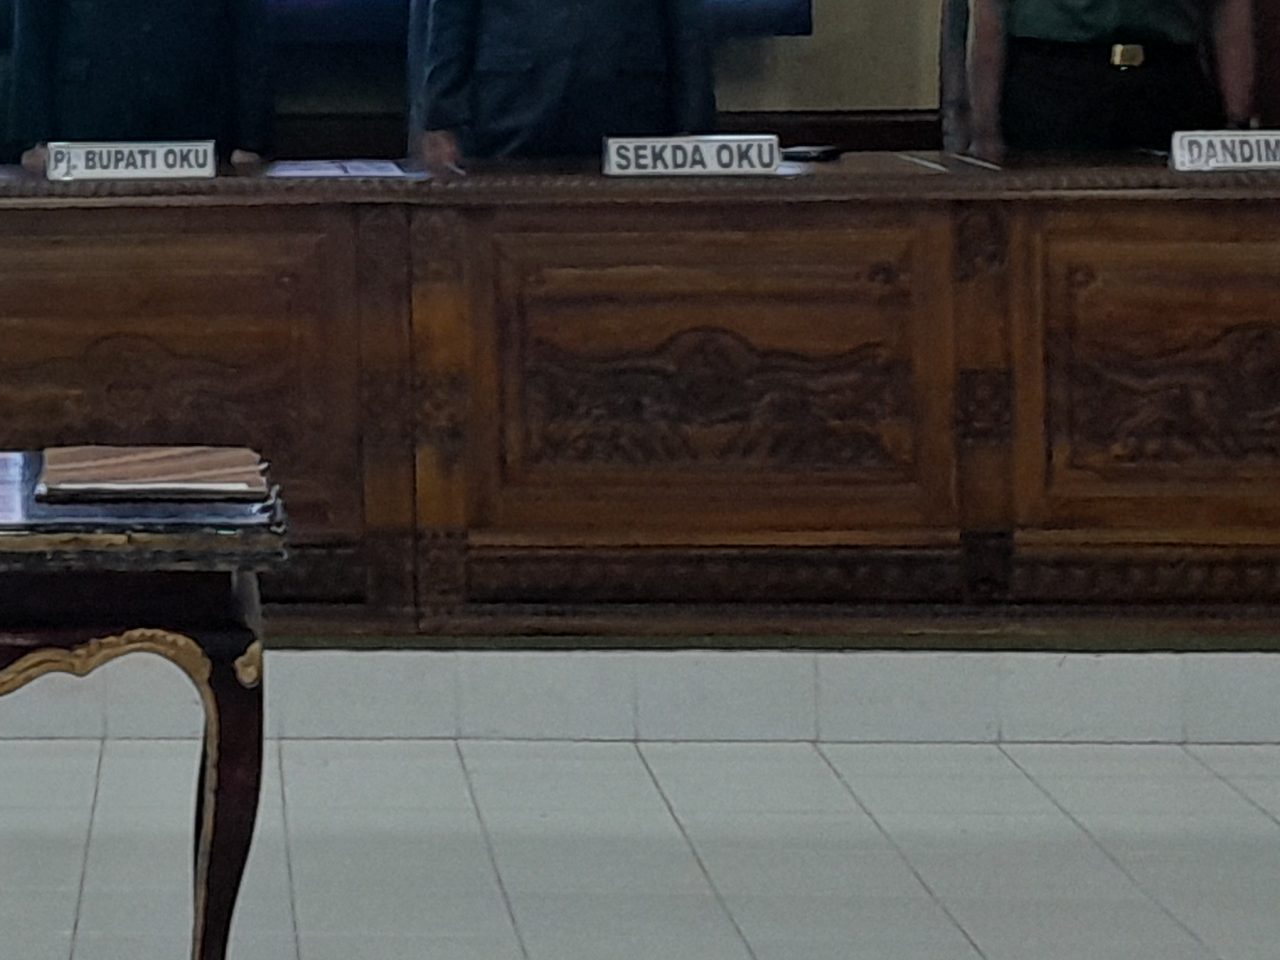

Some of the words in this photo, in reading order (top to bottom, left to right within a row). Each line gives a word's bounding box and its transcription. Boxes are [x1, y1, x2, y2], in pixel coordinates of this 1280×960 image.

[84, 149, 157, 171] BUPATI
[163, 148, 209, 169] OKU
[615, 144, 707, 171] SEKDA
[716, 142, 774, 169] OKU
[1187, 138, 1280, 164] DANDIM
